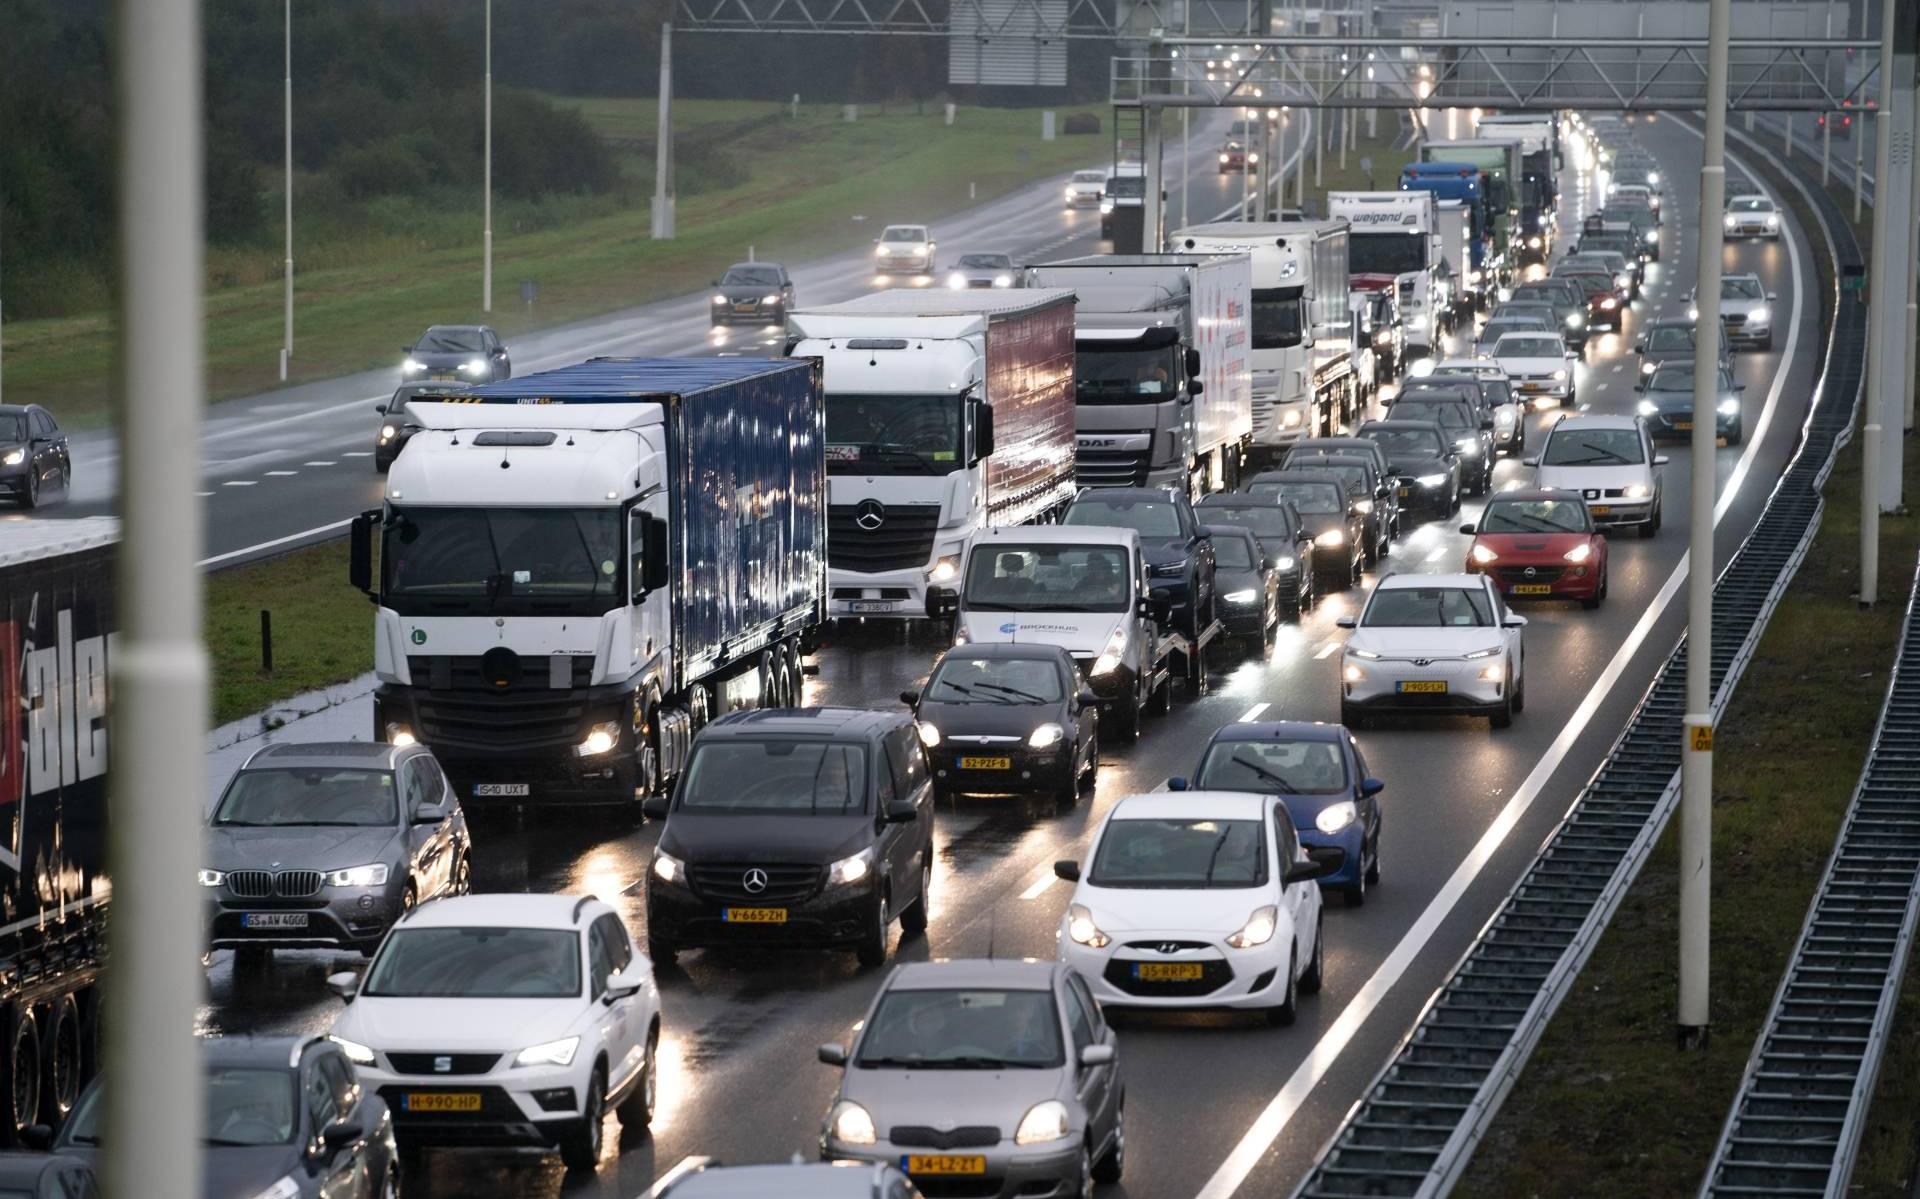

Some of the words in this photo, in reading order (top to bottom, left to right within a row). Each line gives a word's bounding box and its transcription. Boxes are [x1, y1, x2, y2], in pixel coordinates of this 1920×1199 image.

[1353, 212, 1402, 224] weigand
[415, 632, 423, 643] L
[27, 609, 114, 795] ale
[965, 759, 1006, 768] 52-PZF-8
[505, 785, 525, 794] UXT
[732, 910, 784, 921] V-665-ZH
[1142, 965, 1198, 977] 35-RRP-3
[411, 1095, 478, 1108] H-990-HP
[916, 1157, 977, 1171] 34-LZ-ZT
